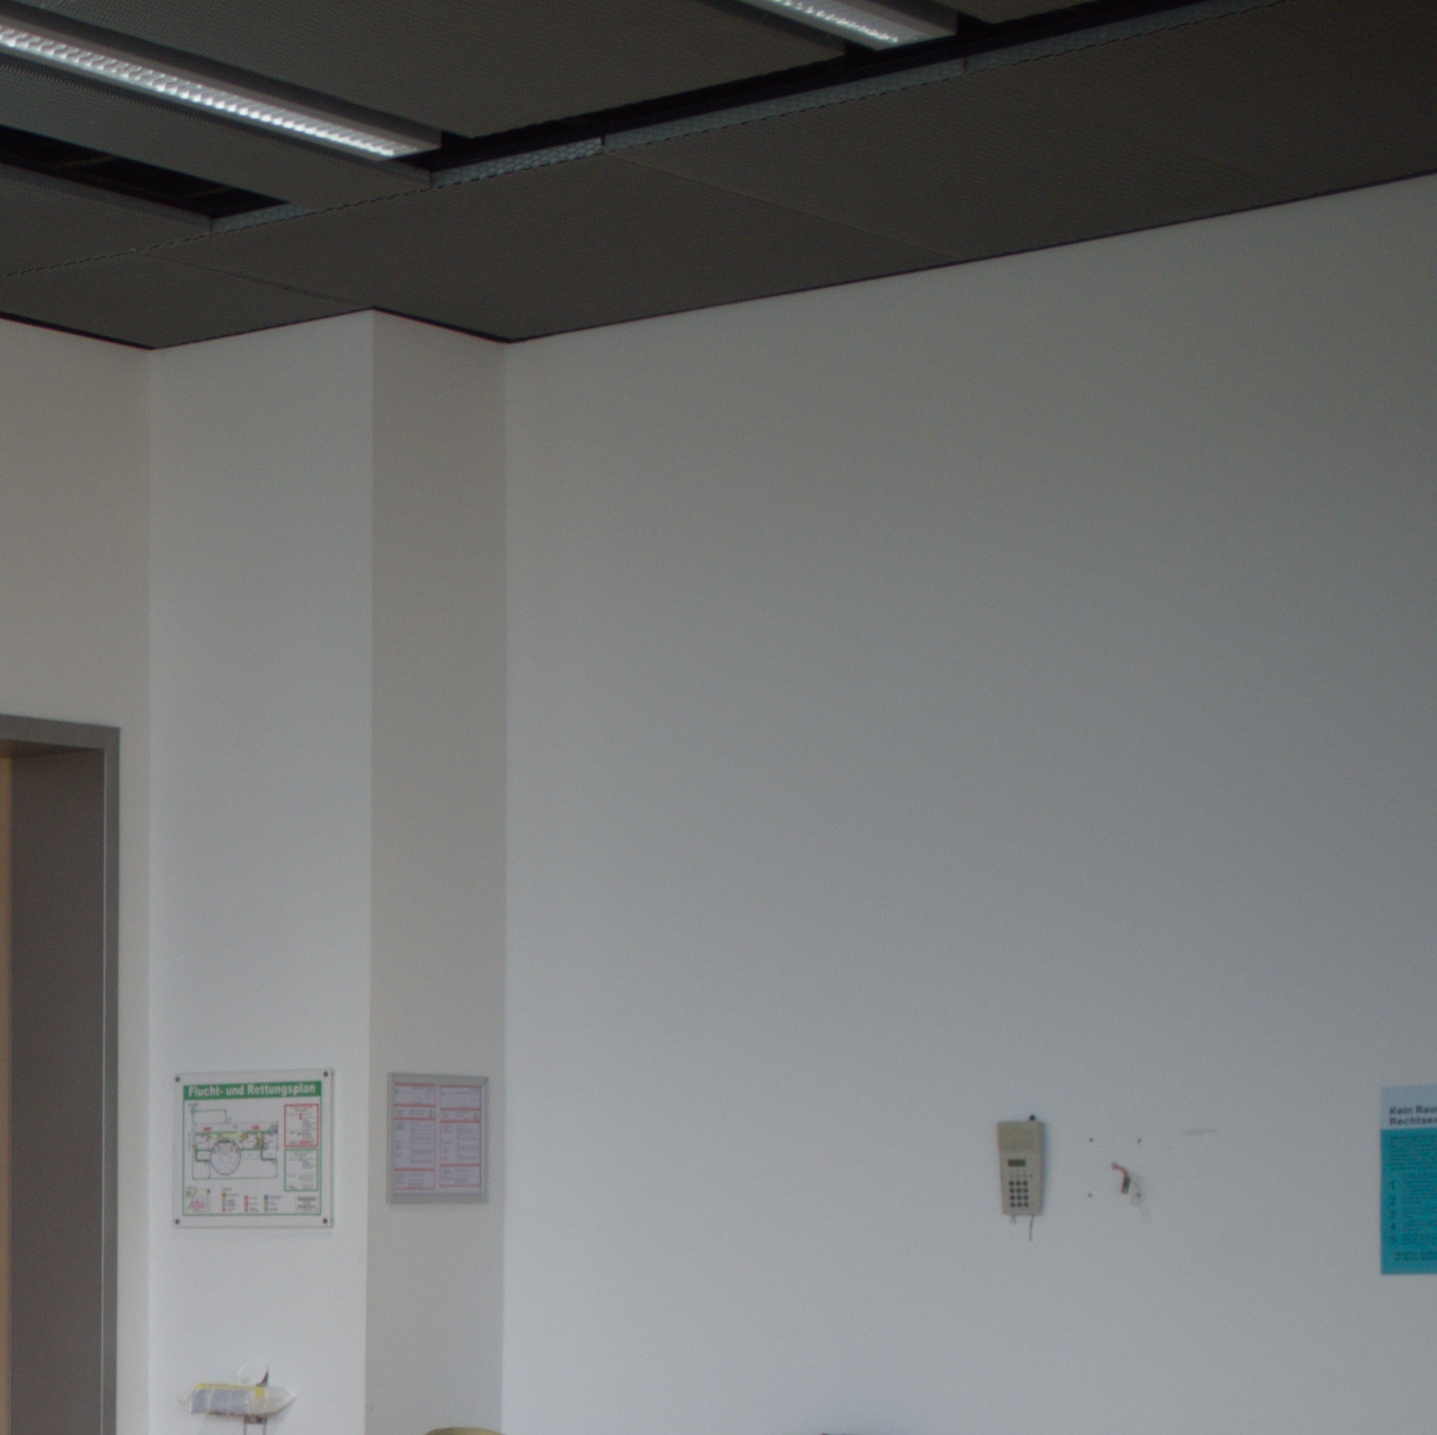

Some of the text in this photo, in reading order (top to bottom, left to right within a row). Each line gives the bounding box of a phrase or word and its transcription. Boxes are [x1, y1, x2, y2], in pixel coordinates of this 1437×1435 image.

[188, 1083, 316, 1097] Flucht- und Rettungsplan
